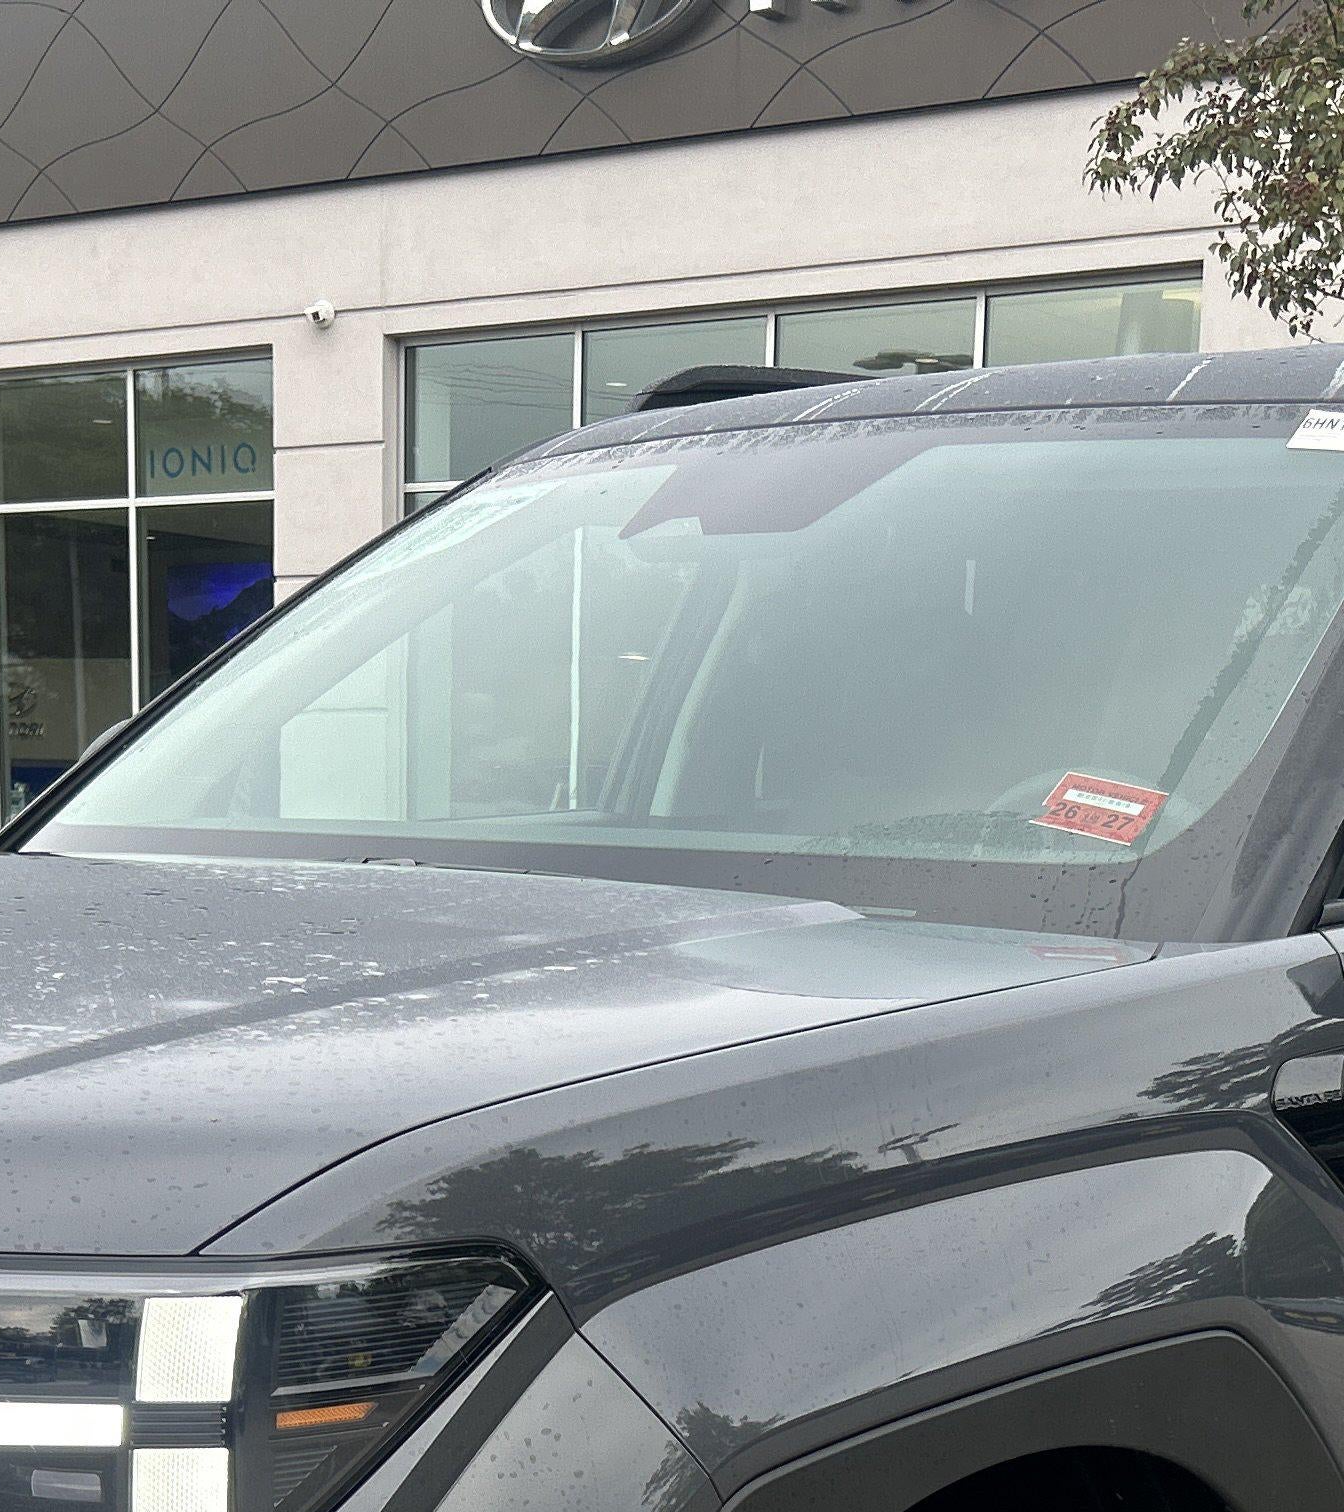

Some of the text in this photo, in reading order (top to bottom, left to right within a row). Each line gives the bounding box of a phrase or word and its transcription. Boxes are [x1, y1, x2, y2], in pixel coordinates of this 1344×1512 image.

[150, 442, 255, 479] IONIQ
[1049, 802, 1135, 831] 26 27
